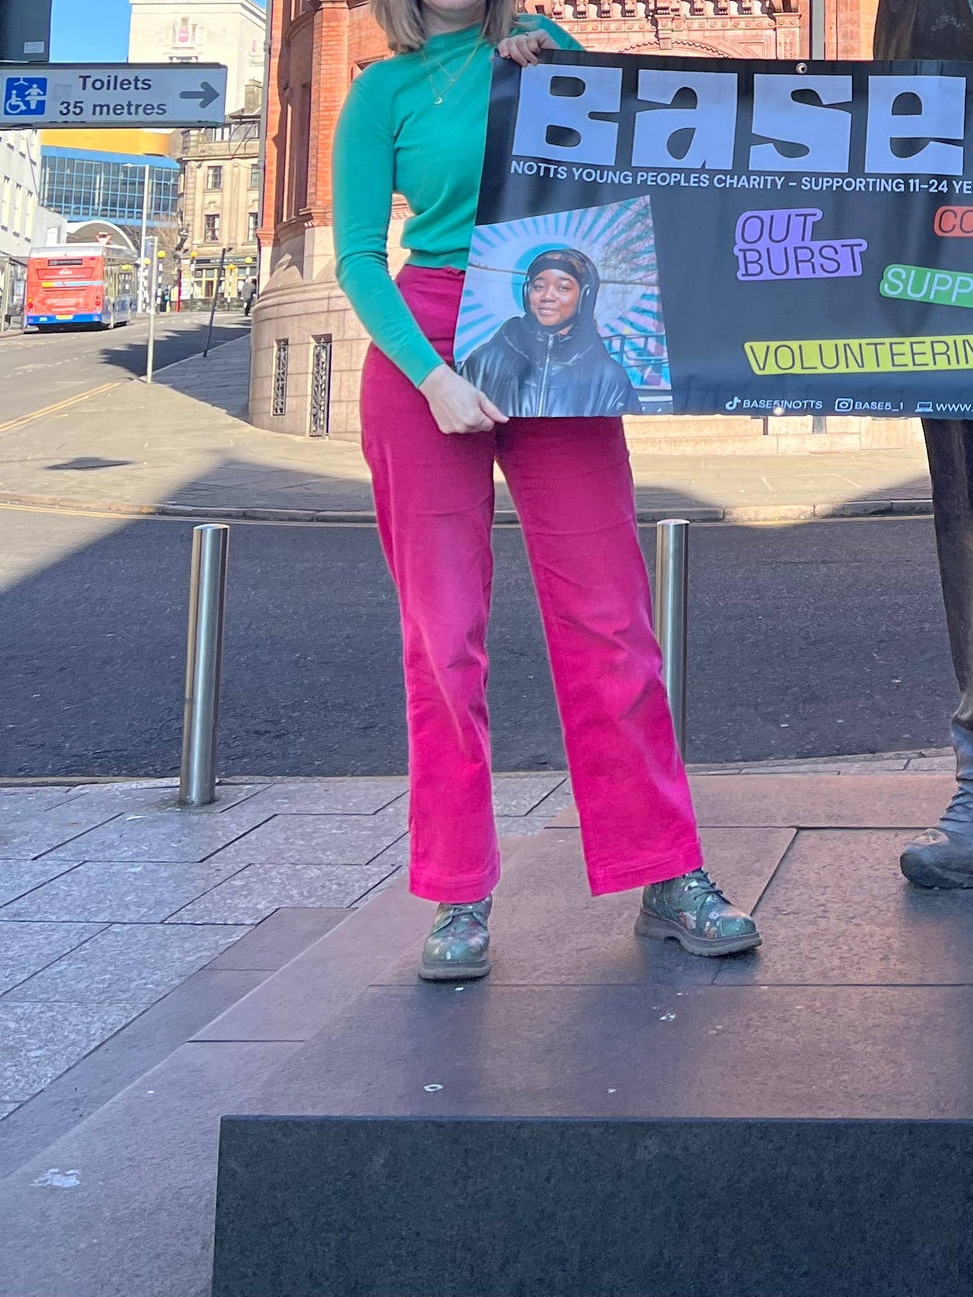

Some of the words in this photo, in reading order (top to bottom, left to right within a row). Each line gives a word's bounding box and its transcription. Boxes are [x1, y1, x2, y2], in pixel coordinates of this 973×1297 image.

[78, 75, 152, 91] Toilets
[59, 100, 84, 116] 35
[91, 101, 167, 116] metres
[510, 160, 568, 180] NOTTS
[572, 167, 633, 186] YOUNG
[636, 171, 710, 189] PEOPLES
[713, 174, 785, 190] CHARITY
[801, 176, 905, 192] SUPPORTING
[741, 213, 817, 244] OUT
[738, 244, 863, 277] BURST
[854, 401, 904, 412] BASE5_1
